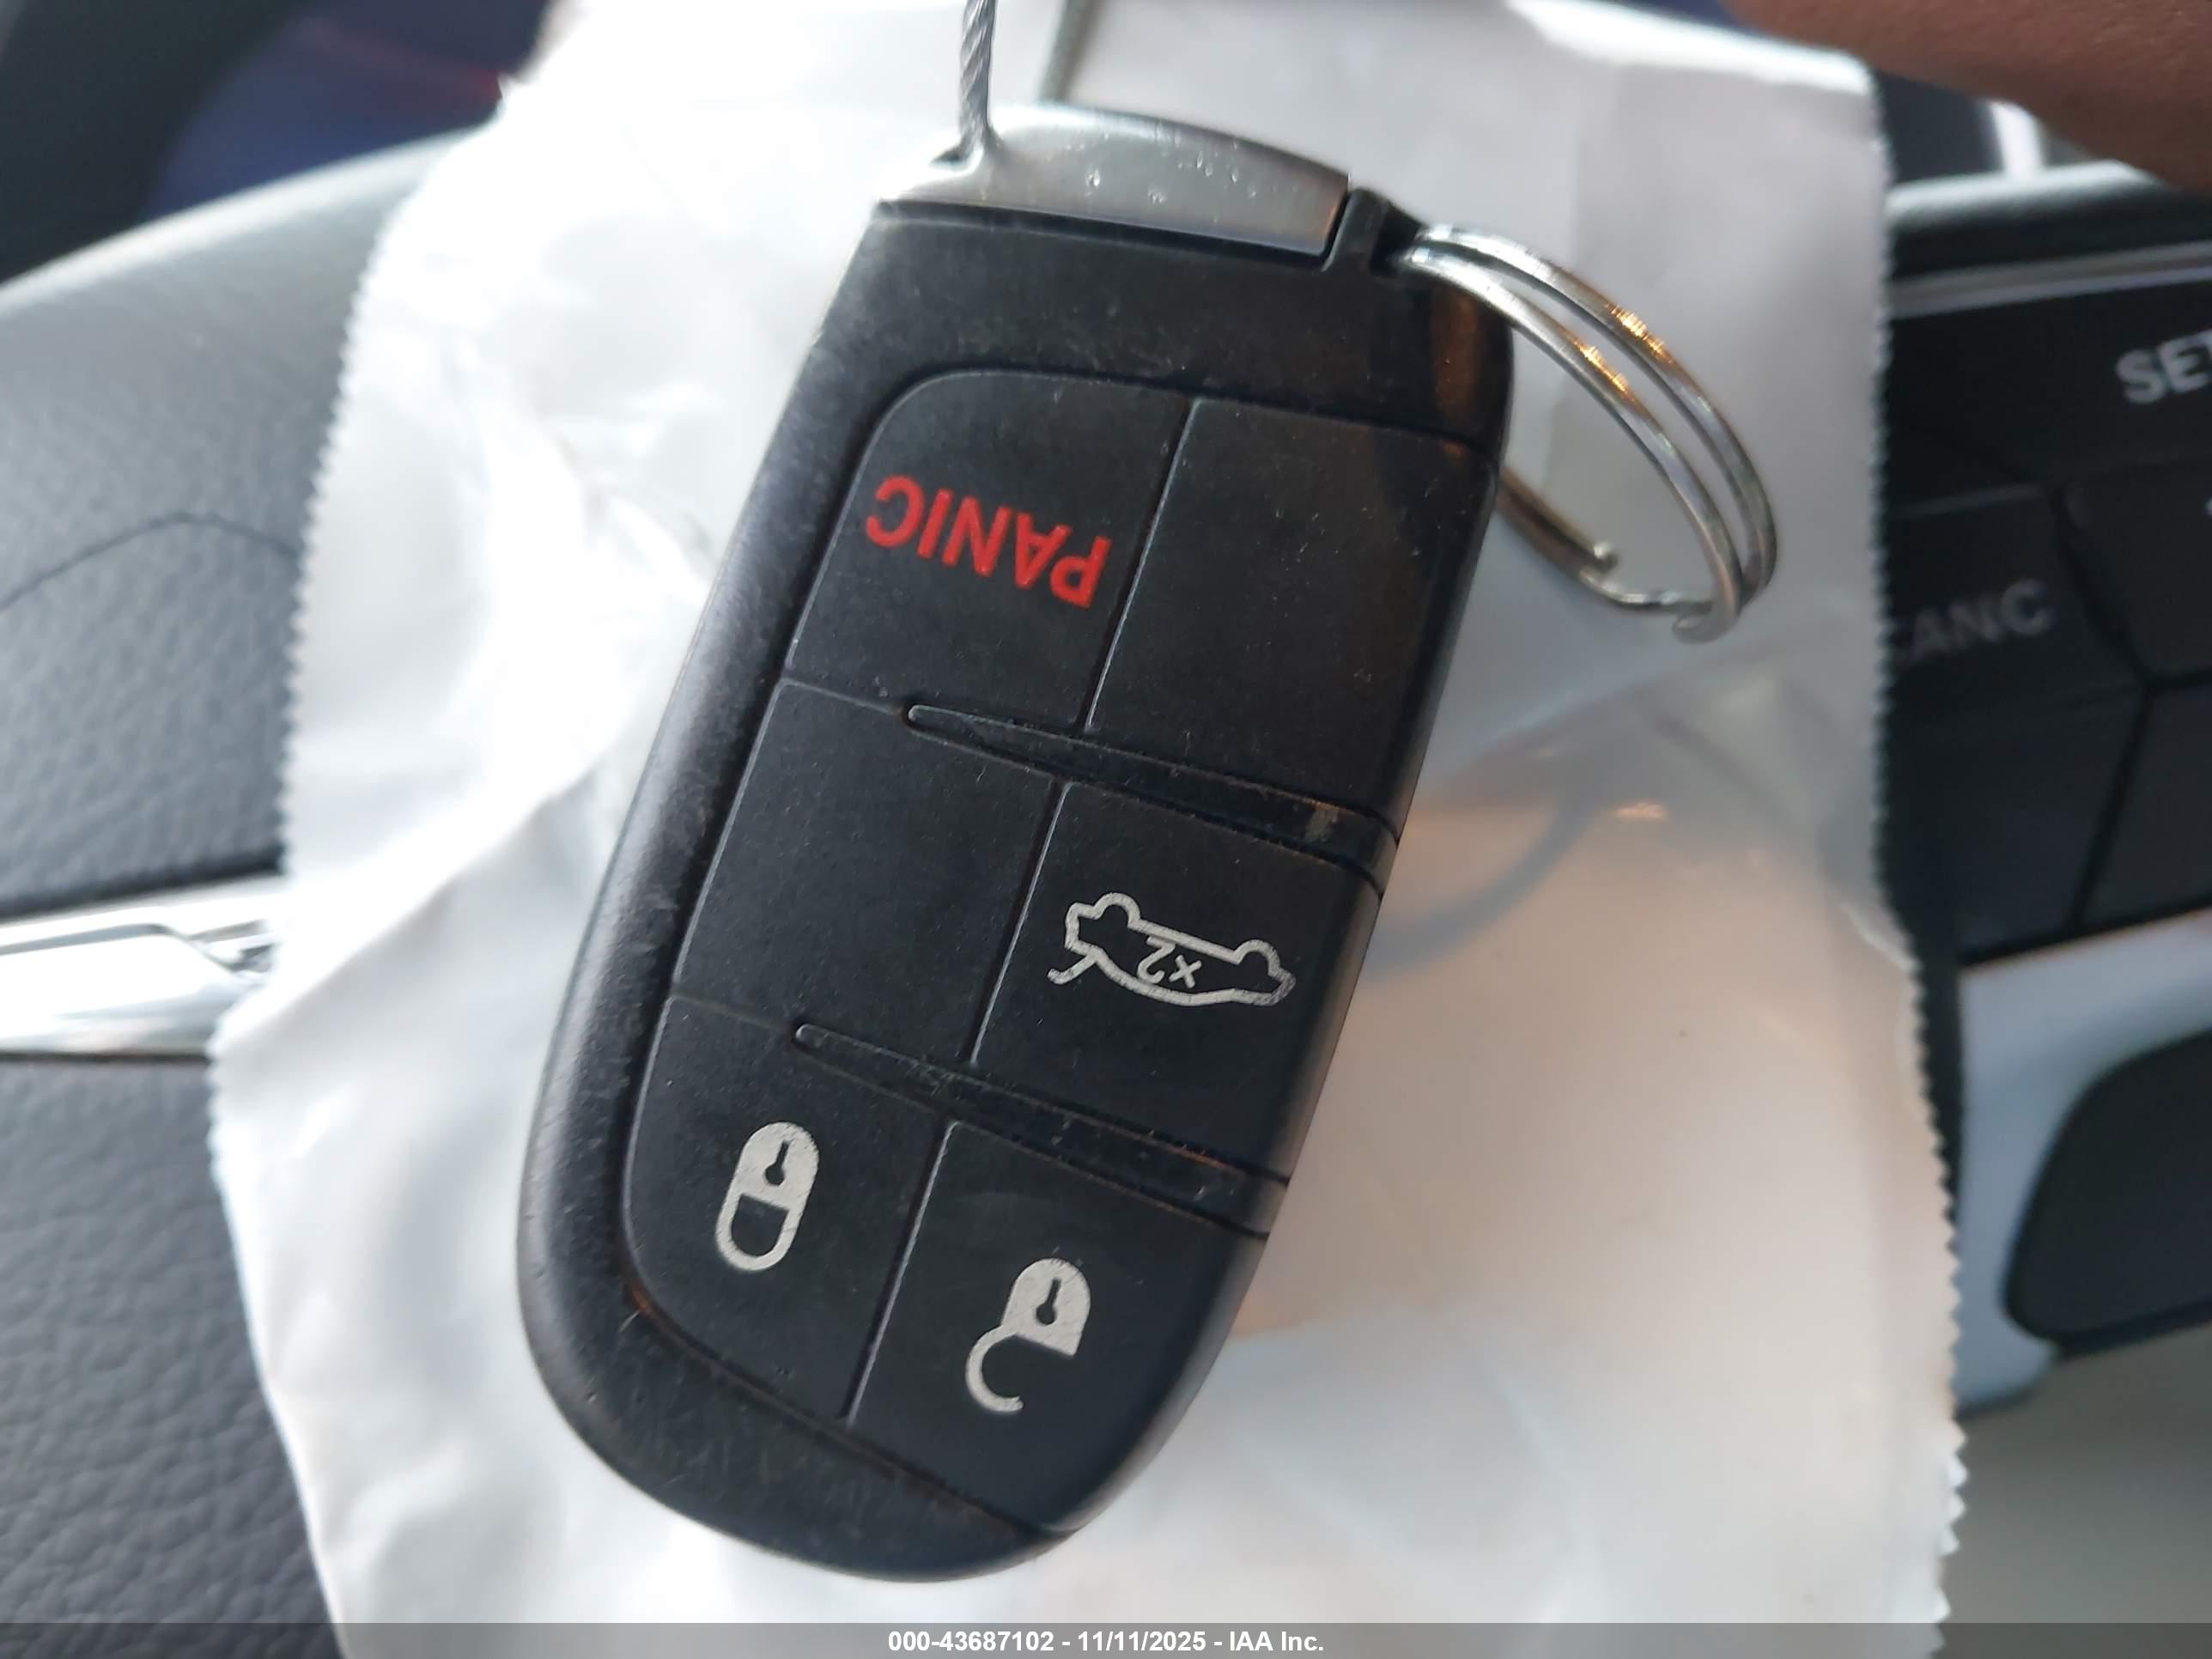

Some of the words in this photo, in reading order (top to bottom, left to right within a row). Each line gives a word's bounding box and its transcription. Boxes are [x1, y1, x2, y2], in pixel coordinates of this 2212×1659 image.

[2115, 329, 2212, 404] SE
[866, 475, 1113, 609] PANIC
[1895, 578, 2057, 666] ANC
